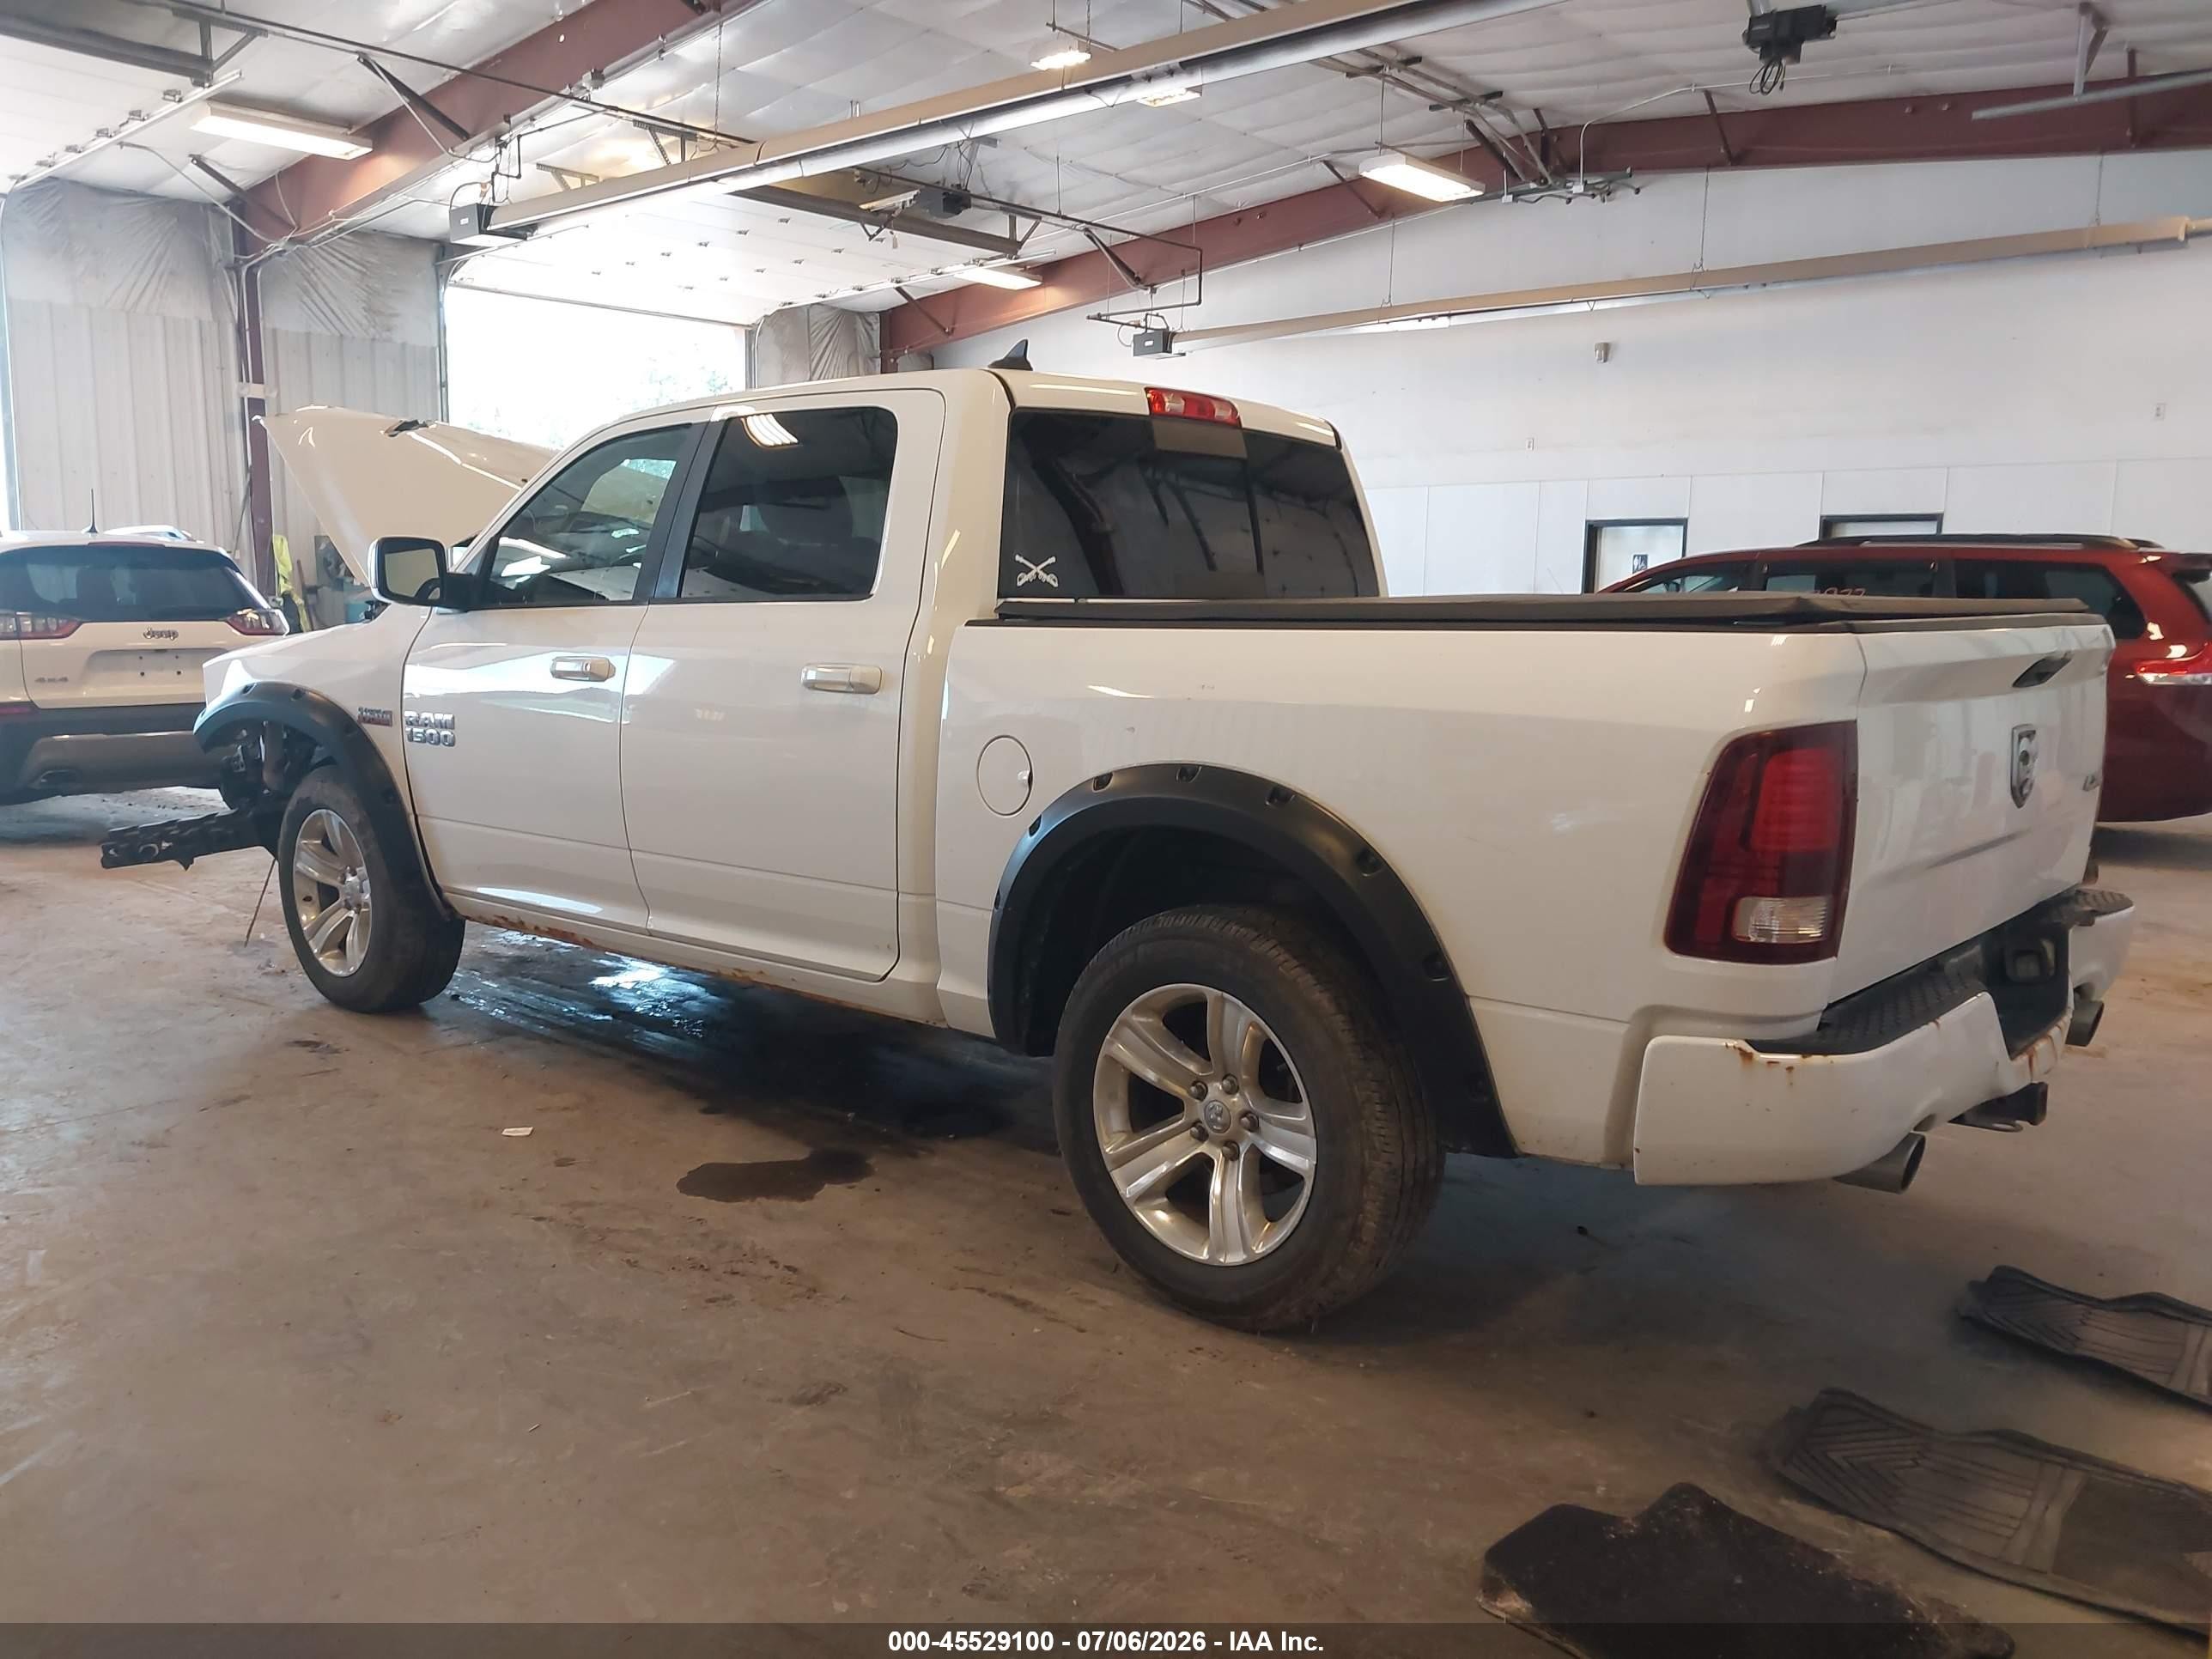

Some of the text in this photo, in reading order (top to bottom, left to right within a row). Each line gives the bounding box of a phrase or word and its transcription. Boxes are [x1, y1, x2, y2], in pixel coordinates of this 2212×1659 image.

[143, 627, 179, 641] Jeep
[404, 710, 455, 730] RAM
[404, 727, 456, 747] 1500
